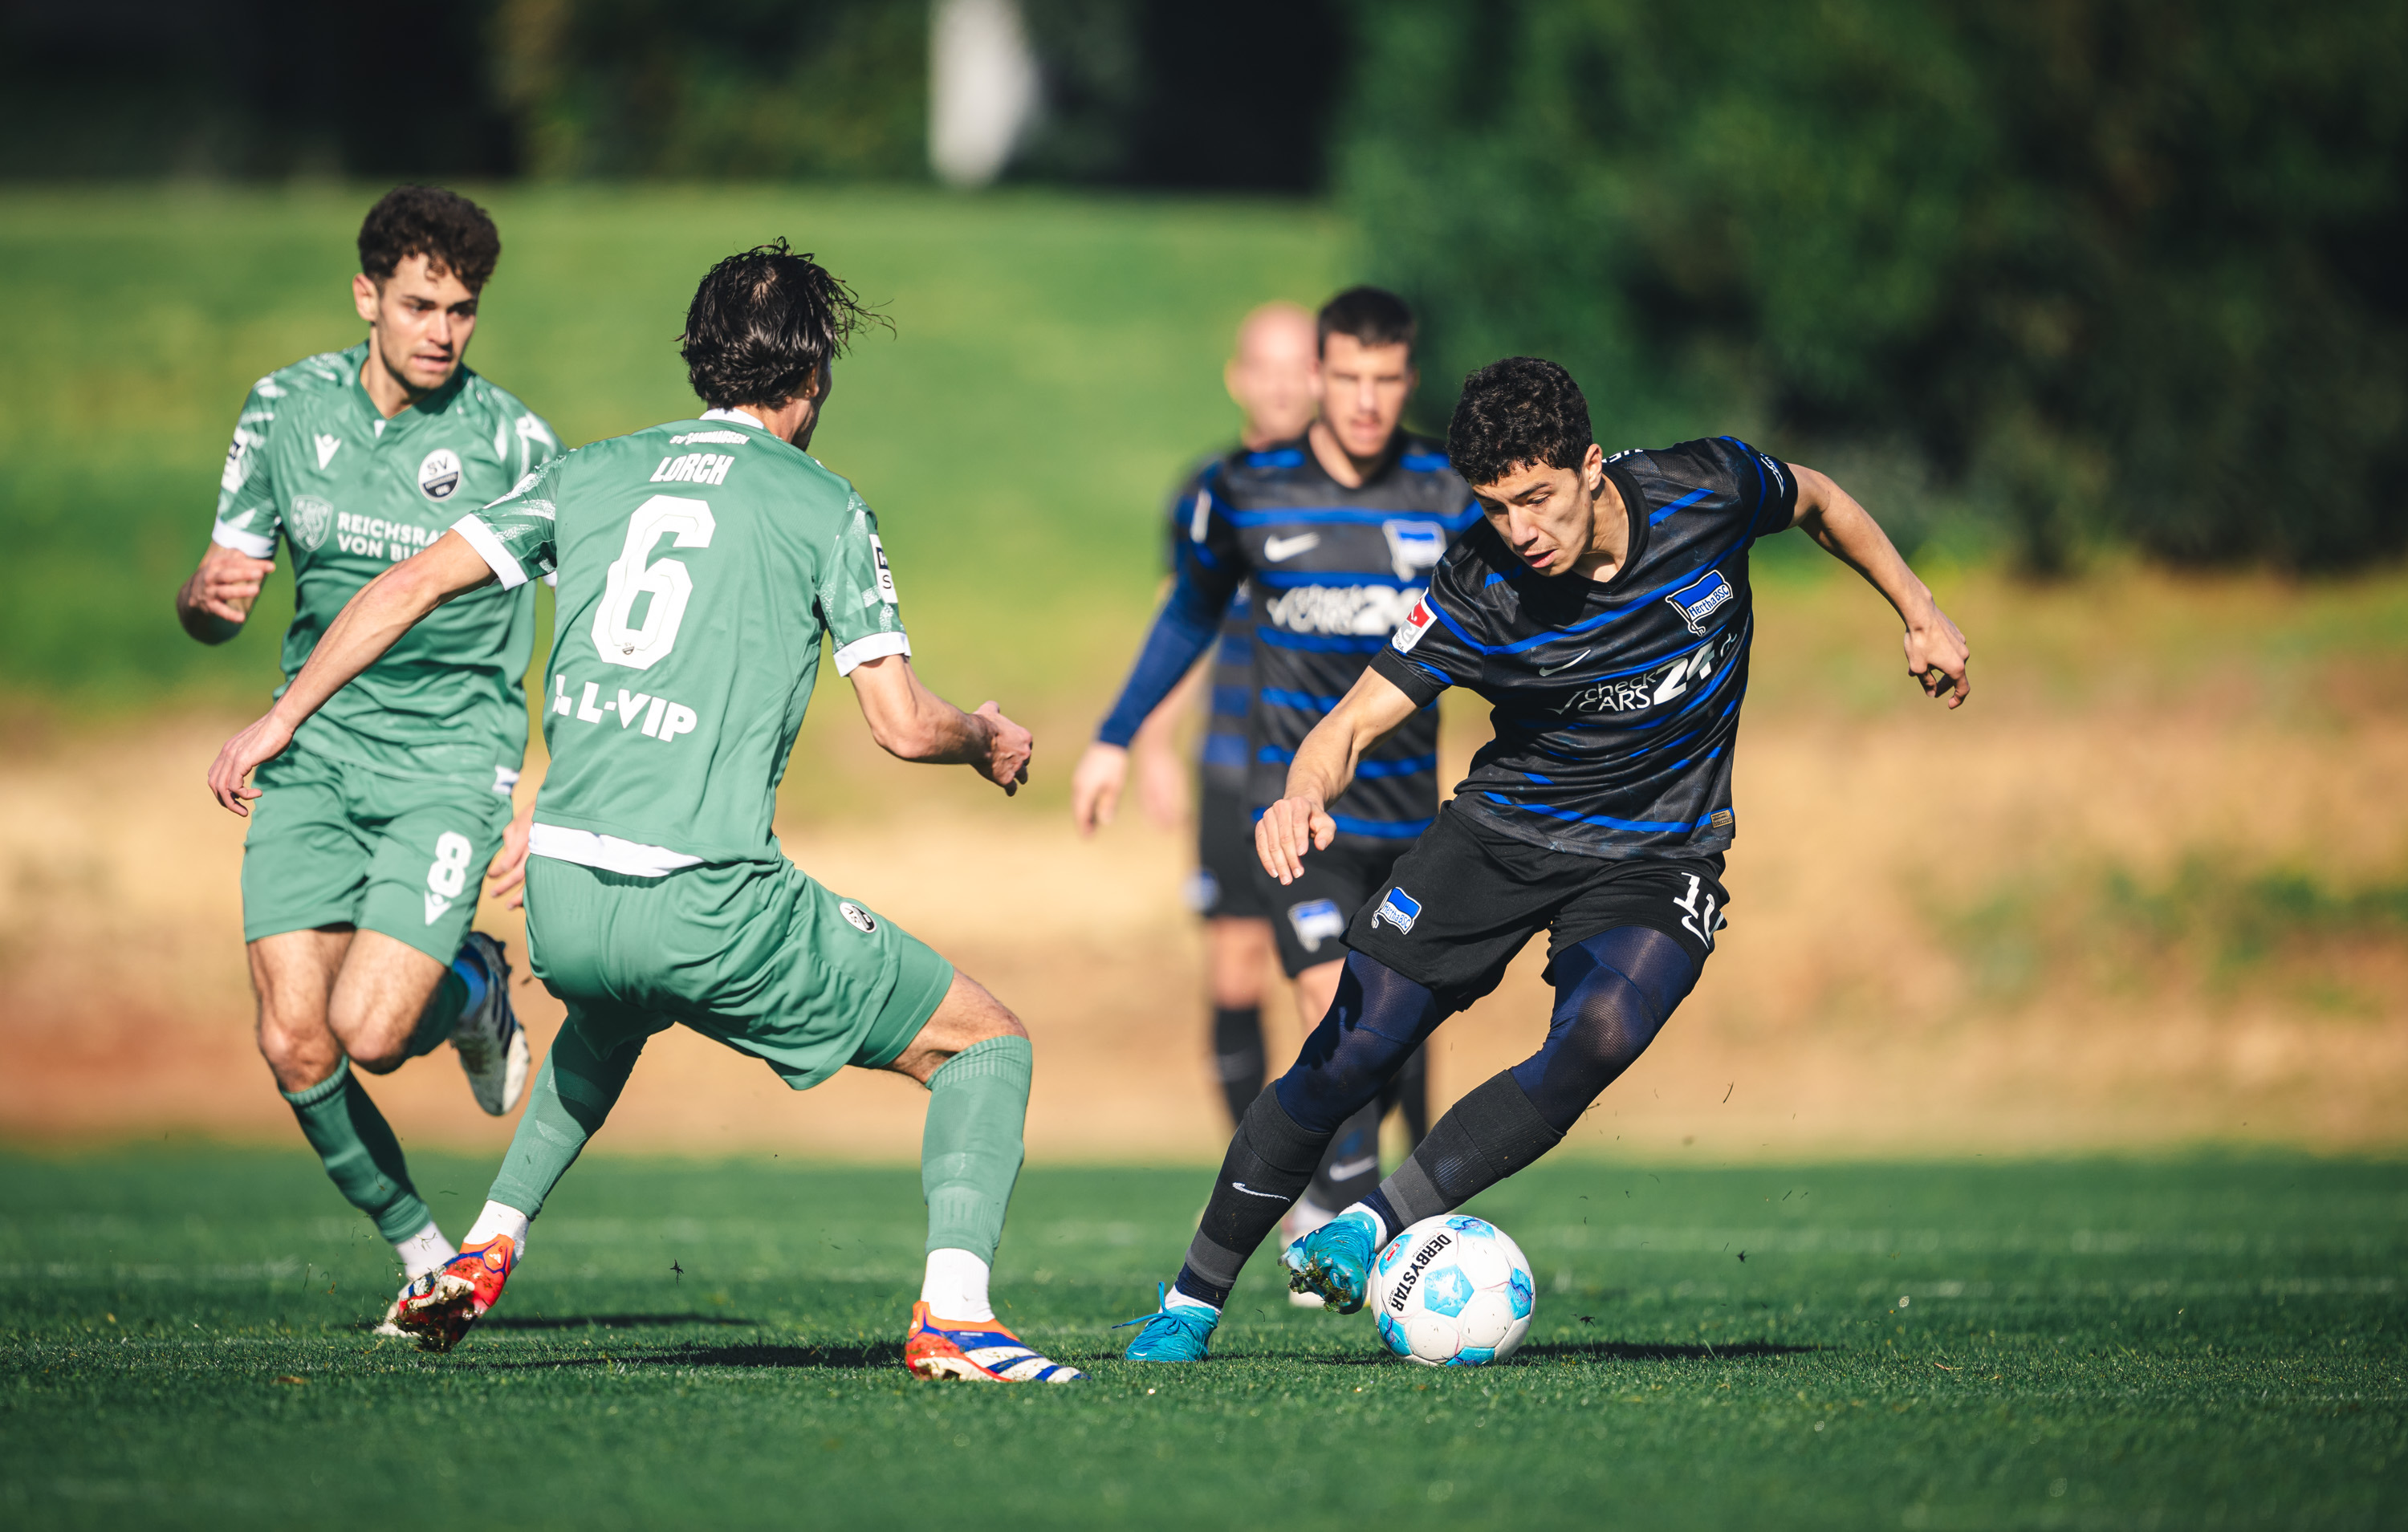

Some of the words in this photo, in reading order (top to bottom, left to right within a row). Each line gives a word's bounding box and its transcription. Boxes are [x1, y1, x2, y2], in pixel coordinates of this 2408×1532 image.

[427, 457, 448, 475] SV
[649, 453, 735, 486] LORCH
[337, 511, 448, 547] REICHSRA
[337, 532, 384, 559] VON
[591, 494, 717, 671] 6
[1576, 685, 1651, 713] CARS
[1584, 673, 1657, 701] check
[426, 831, 473, 899] 8
[1390, 1233, 1453, 1312] DERBYSTAR
